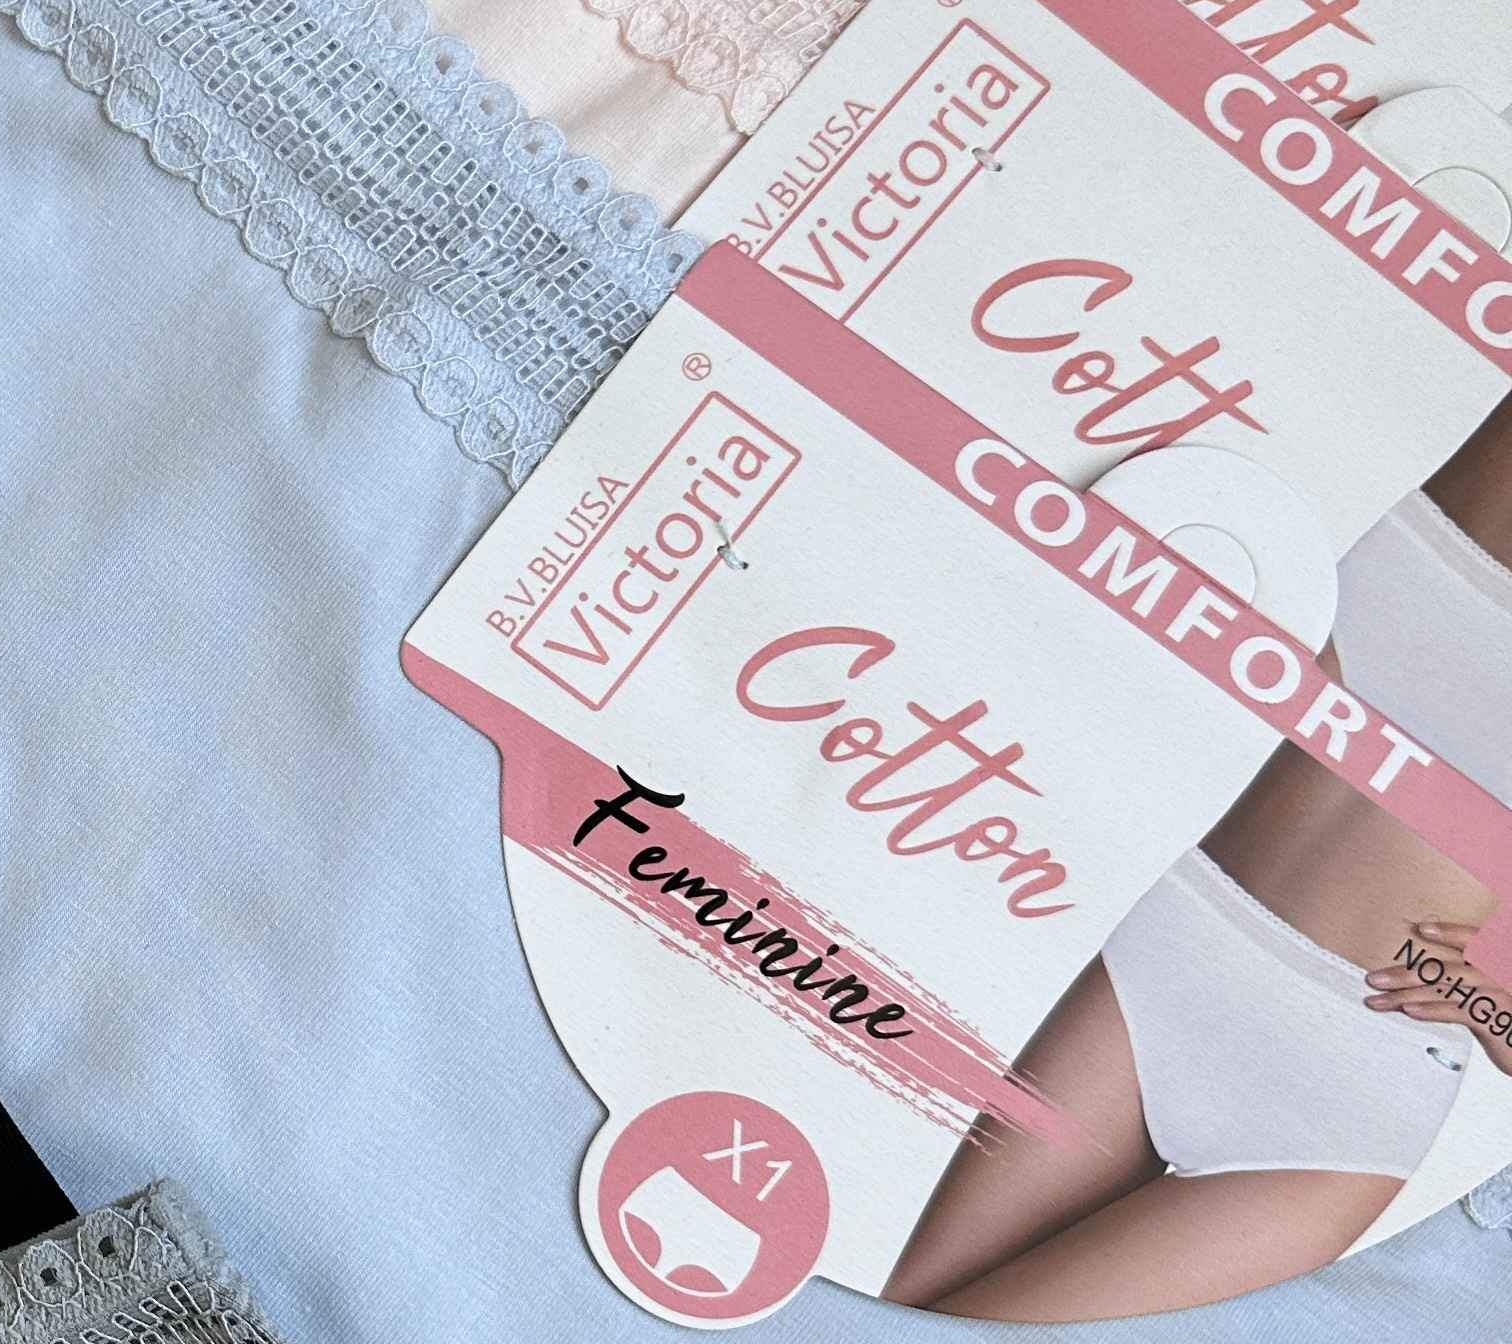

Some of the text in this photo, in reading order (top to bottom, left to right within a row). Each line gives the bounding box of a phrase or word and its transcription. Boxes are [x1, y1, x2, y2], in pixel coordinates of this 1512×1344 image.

[778, 64, 1019, 291] Victoria
[1204, 73, 1512, 349] COMFO
[971, 259, 1270, 462] Cott
[486, 476, 629, 638] B.V.BLUISA
[543, 436, 771, 665] Victoria
[954, 438, 1432, 794] COMFORT
[735, 626, 1076, 917] Cotton
[573, 765, 916, 1039] Feminine
[1393, 938, 1512, 1048] NO:HG9
[702, 1118, 794, 1202] X1
